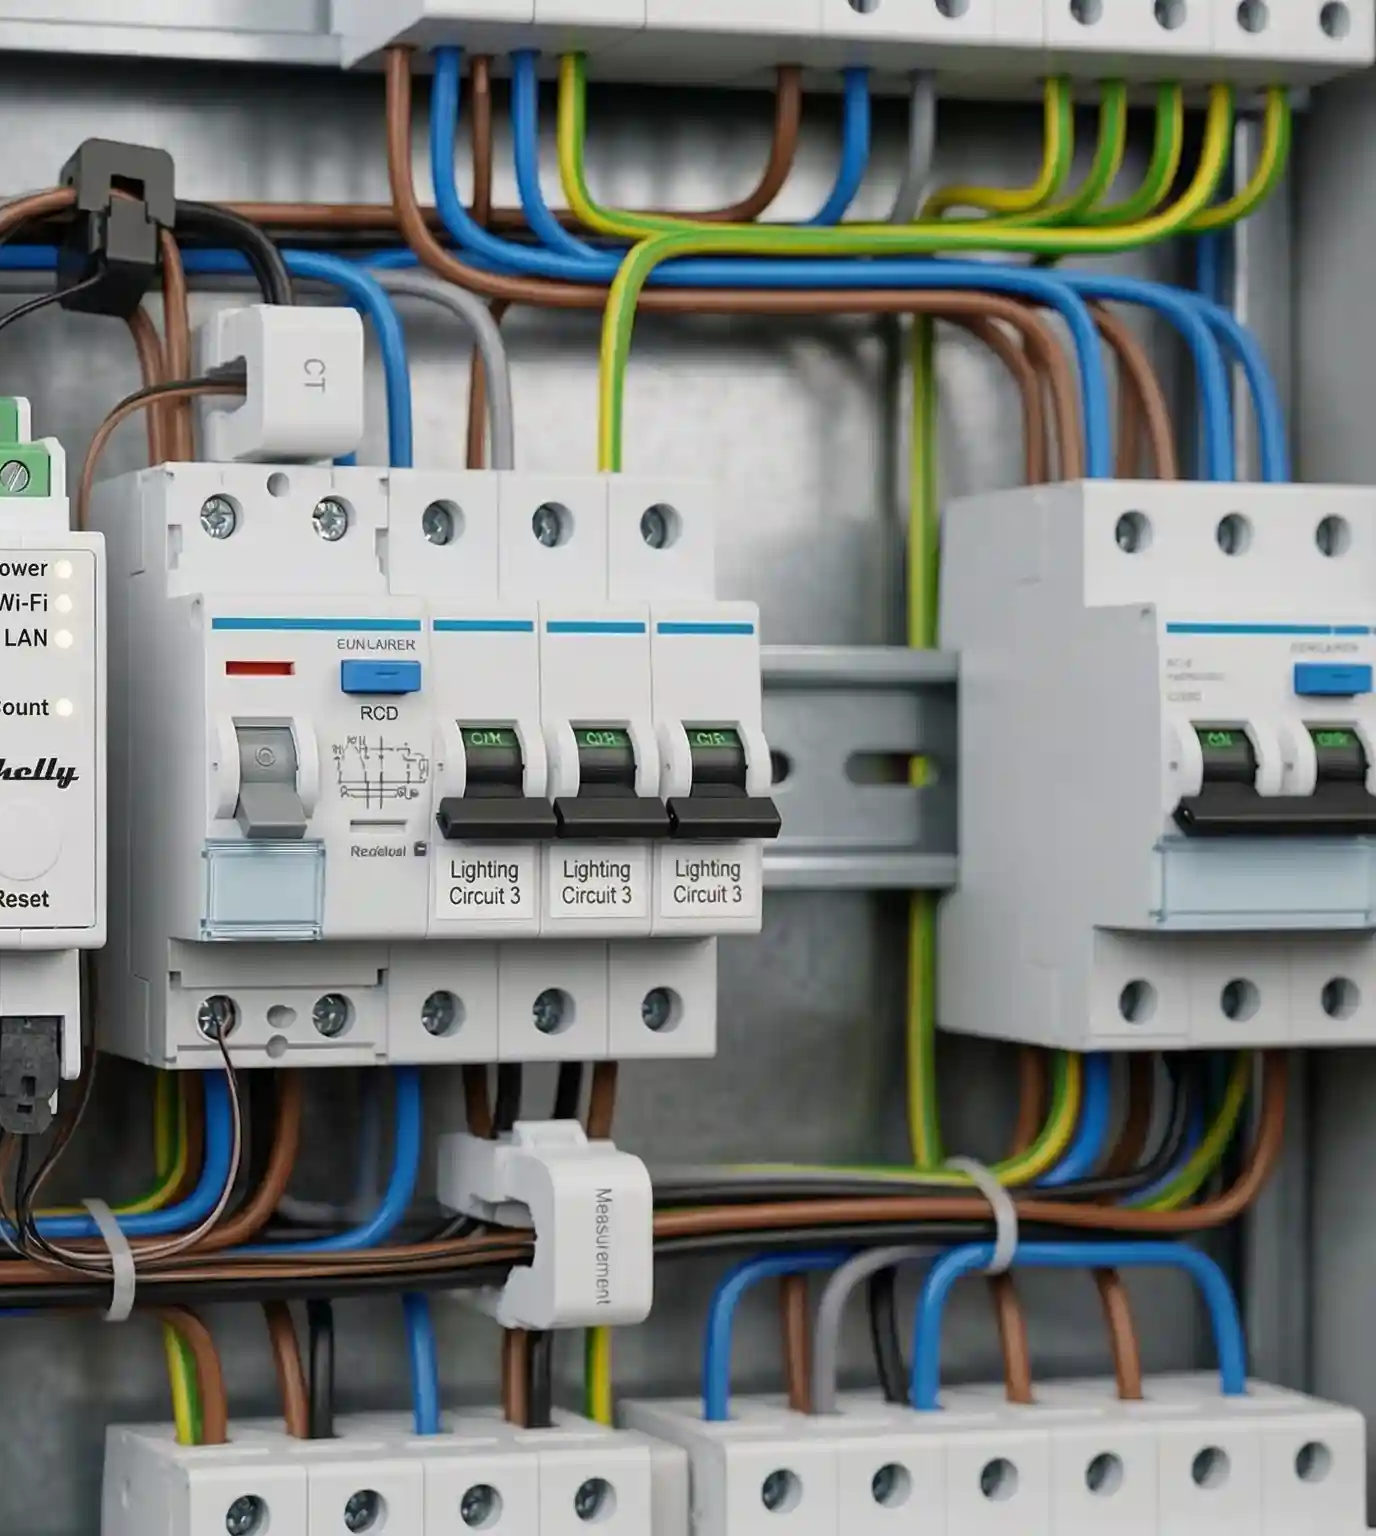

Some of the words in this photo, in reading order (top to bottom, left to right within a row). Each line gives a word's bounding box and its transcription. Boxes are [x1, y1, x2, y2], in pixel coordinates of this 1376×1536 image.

[302, 358, 326, 393] CT
[5, 629, 47, 646] LAN
[361, 706, 398, 720] RCD
[452, 860, 518, 883] Lighting
[564, 860, 630, 883] Lighting
[676, 859, 740, 882] Lighting
[450, 887, 503, 905] Circuit
[511, 886, 520, 904] 3
[563, 886, 615, 904] Circuit
[622, 886, 631, 903] 3
[674, 885, 727, 903] Circuit
[733, 885, 741, 902] 3
[596, 1189, 612, 1305] Measurement
